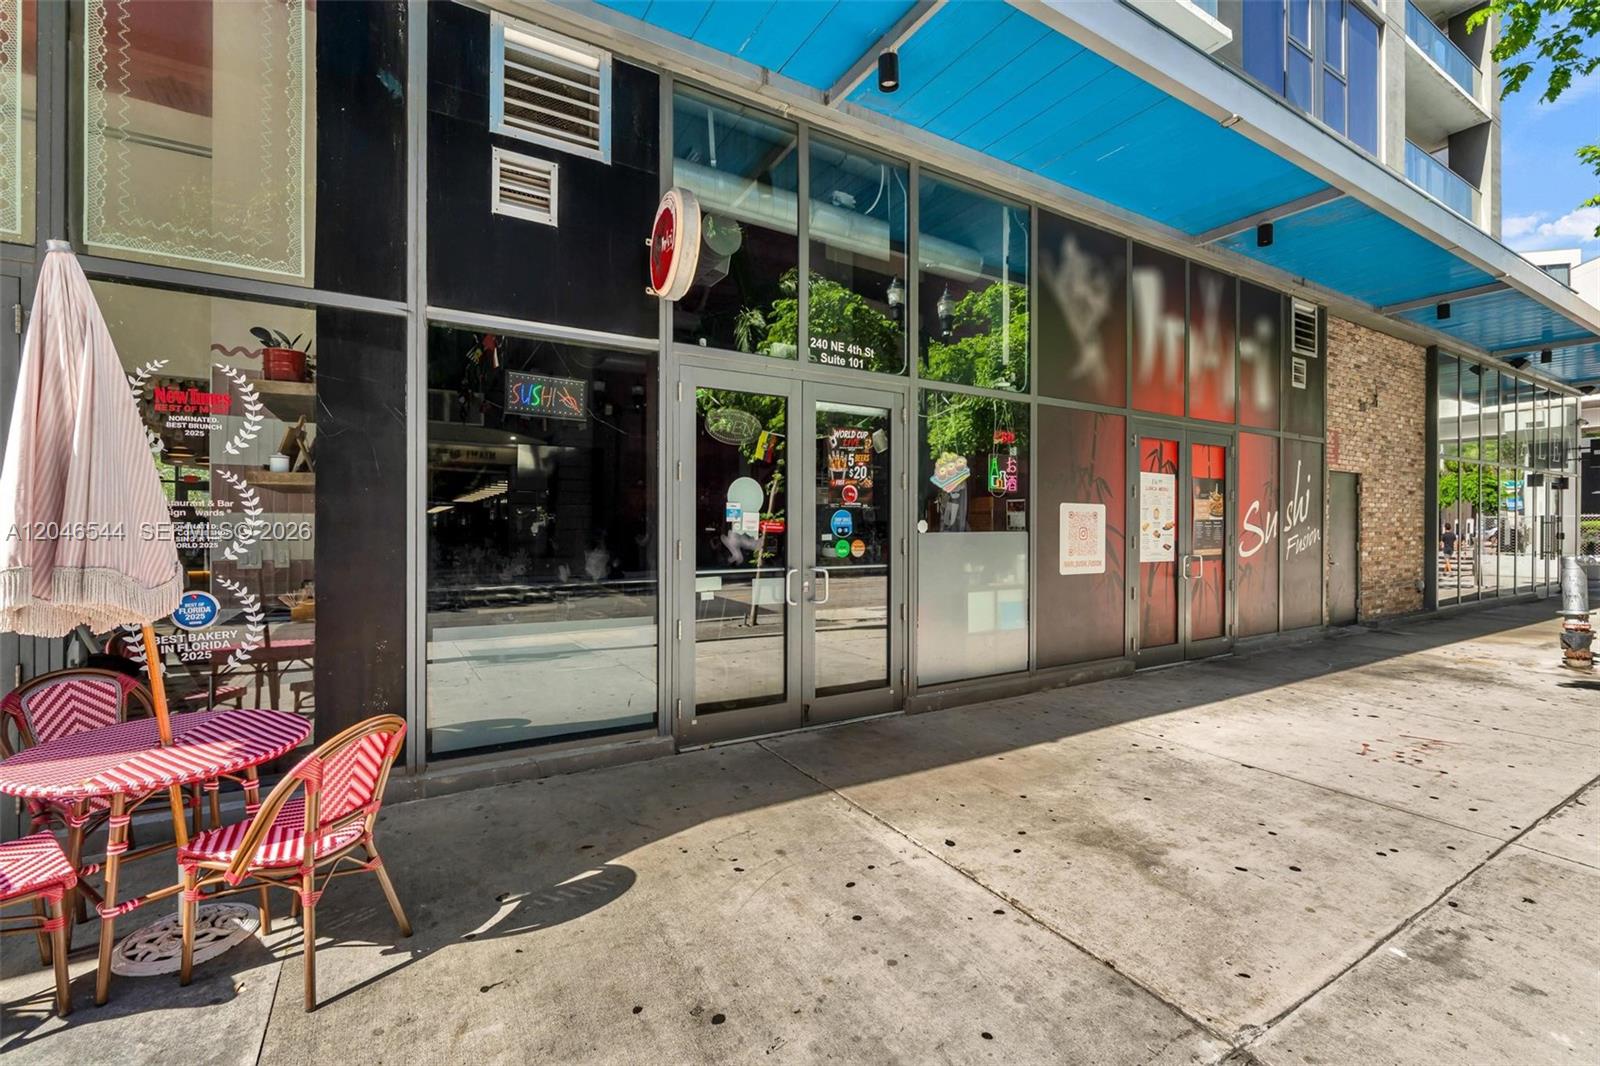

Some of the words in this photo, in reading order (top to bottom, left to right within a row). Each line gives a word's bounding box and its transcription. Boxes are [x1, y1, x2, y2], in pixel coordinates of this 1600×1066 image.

[810, 337, 828, 350] 240
[830, 341, 845, 353] NE
[847, 343, 862, 356] 4th
[864, 347, 875, 358] St
[820, 352, 846, 366] Suite
[848, 356, 864, 369] 101
[154, 386, 187, 403] New
[511, 382, 557, 408] SUSHI
[154, 404, 182, 412] BEST
[183, 405, 198, 413] OF
[833, 430, 856, 440] WORLD
[856, 430, 869, 440] CUP
[847, 453, 855, 467] 5
[849, 466, 867, 479] $20
[207, 499, 215, 507] &
[1239, 459, 1312, 557] Sushi
[1285, 526, 1321, 561] Fusion
[179, 606, 211, 614] FLORIDA
[155, 634, 187, 645] BEST
[188, 629, 239, 642] BAKERY
[160, 645, 175, 654] IN
[177, 640, 231, 652] FLORIDA
[181, 650, 212, 661] 2025
